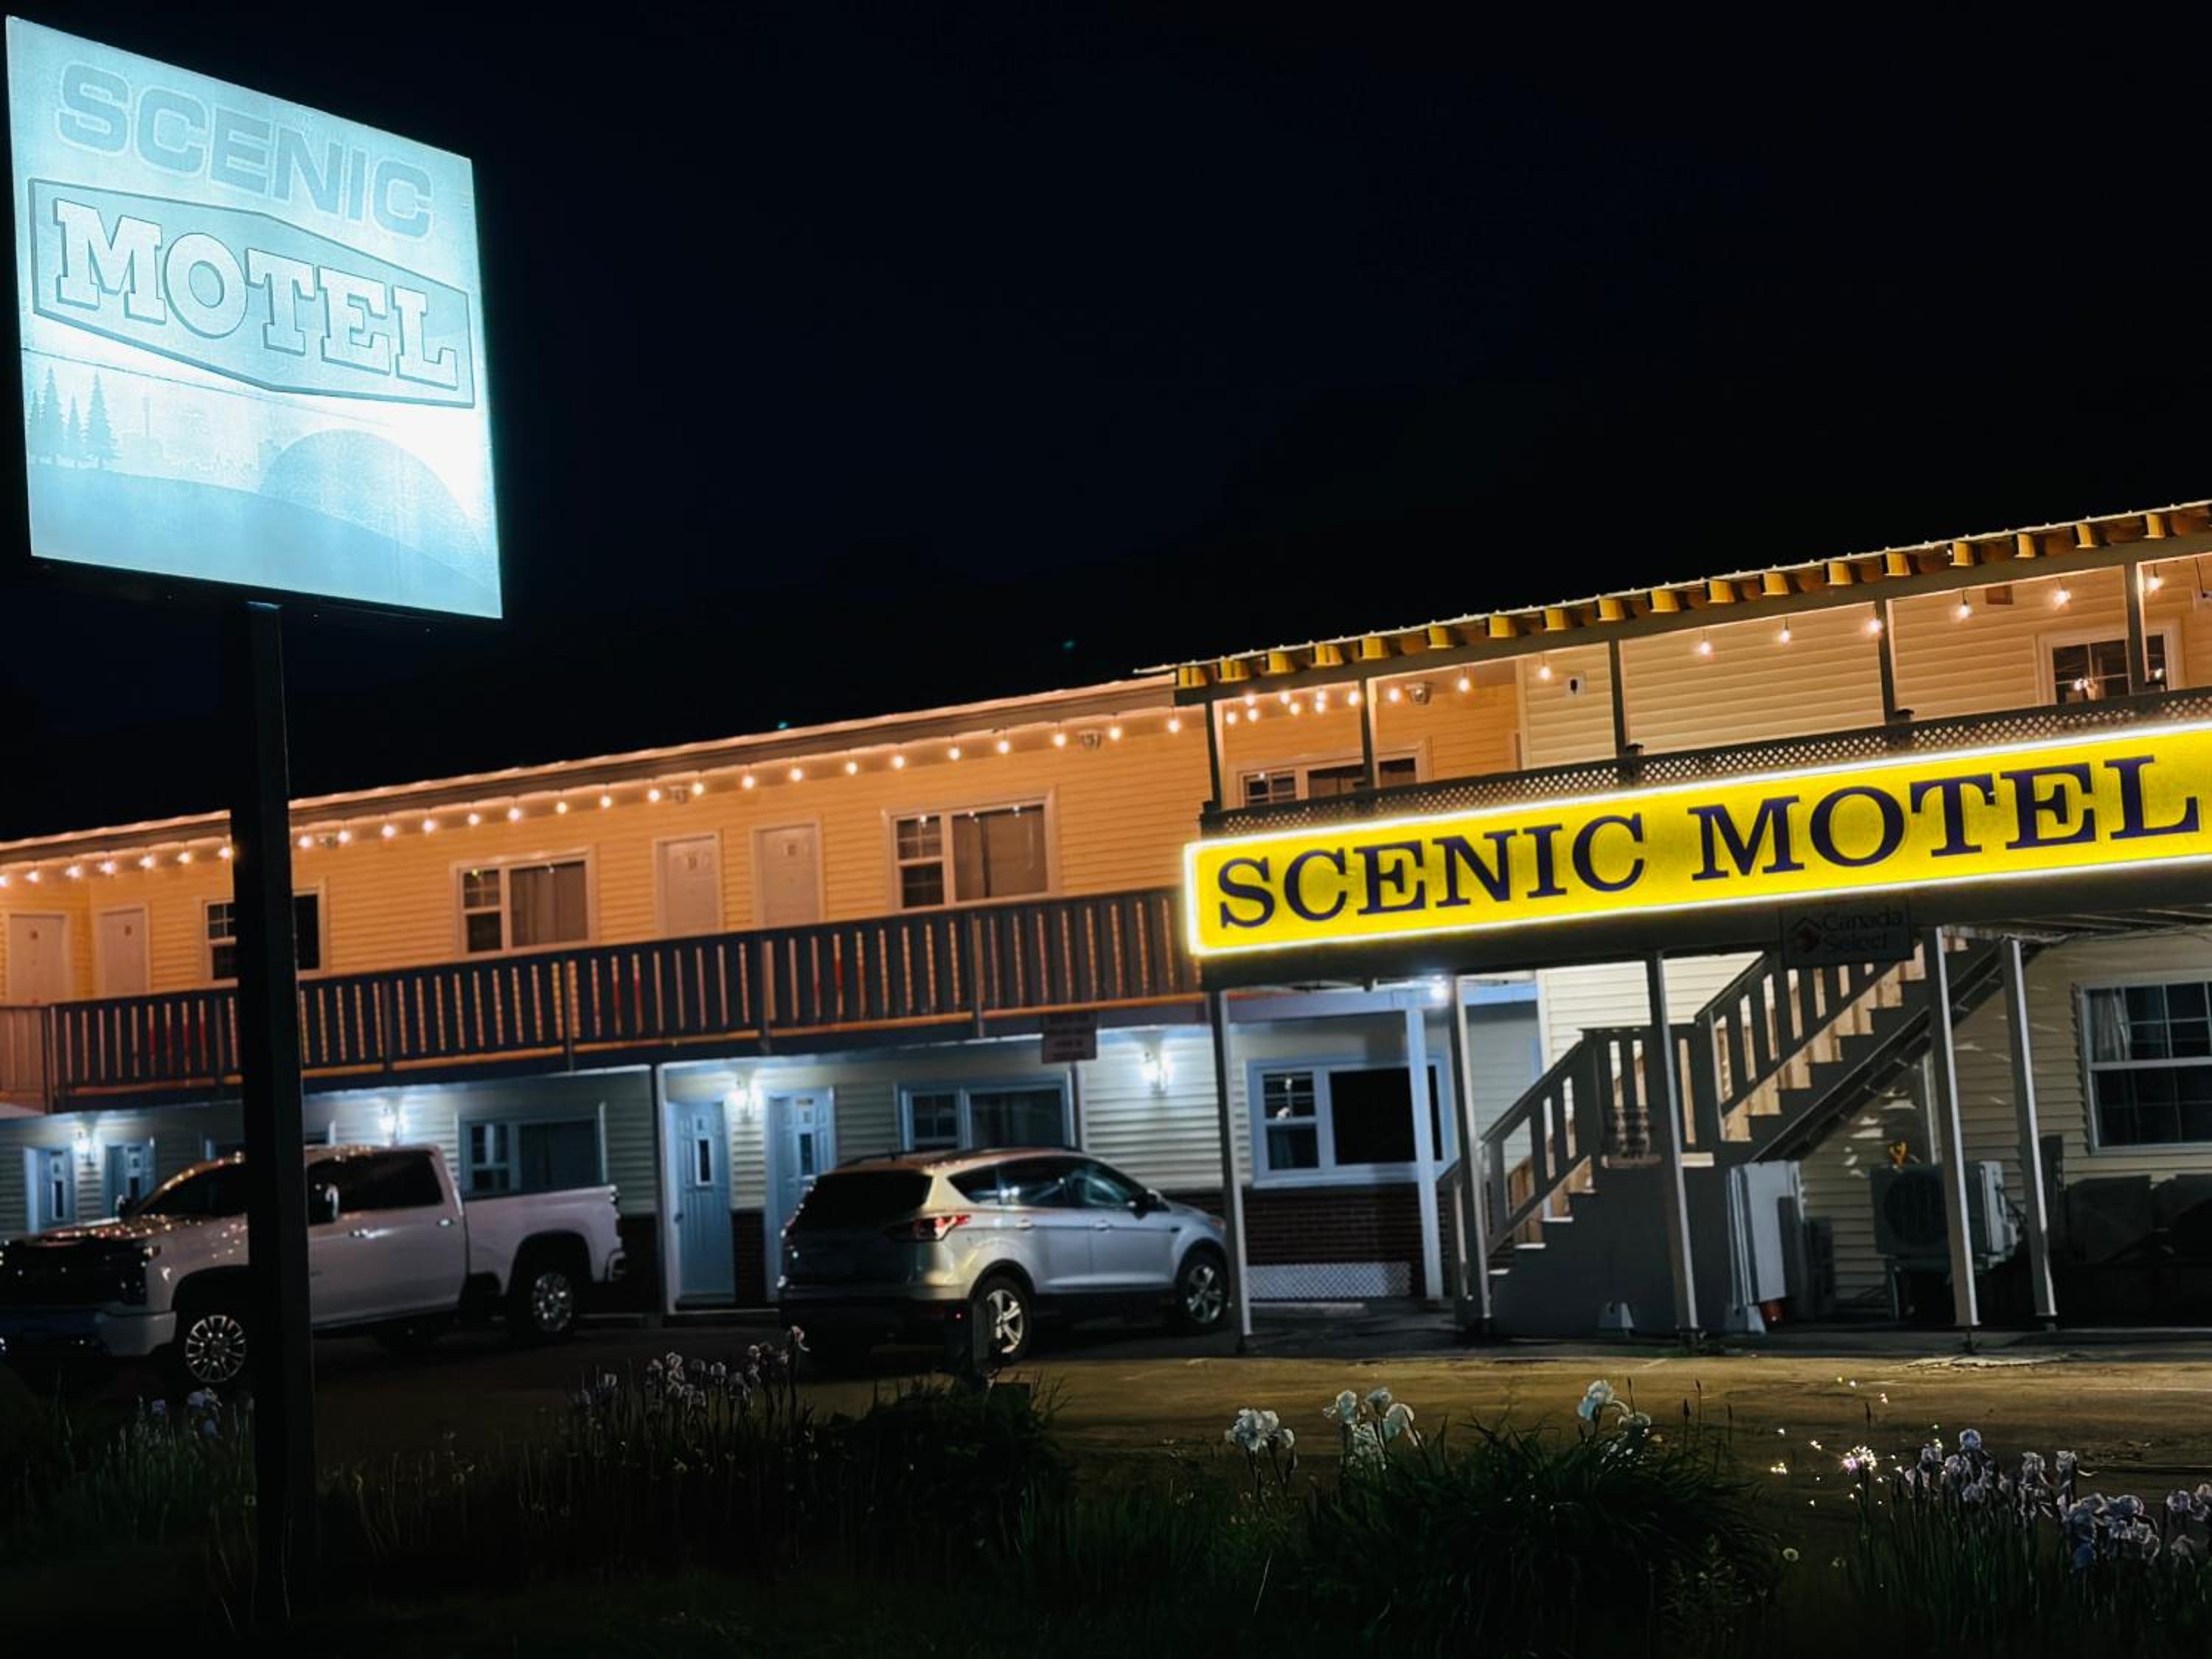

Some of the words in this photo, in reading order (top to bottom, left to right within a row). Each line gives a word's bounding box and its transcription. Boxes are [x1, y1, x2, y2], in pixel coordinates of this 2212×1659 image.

[58, 63, 434, 238] SCENIC
[54, 198, 459, 390] MOTEL
[1217, 813, 1646, 929] SCENIC
[1687, 754, 2200, 881] MOTEL
[1823, 908, 1902, 932] Canada
